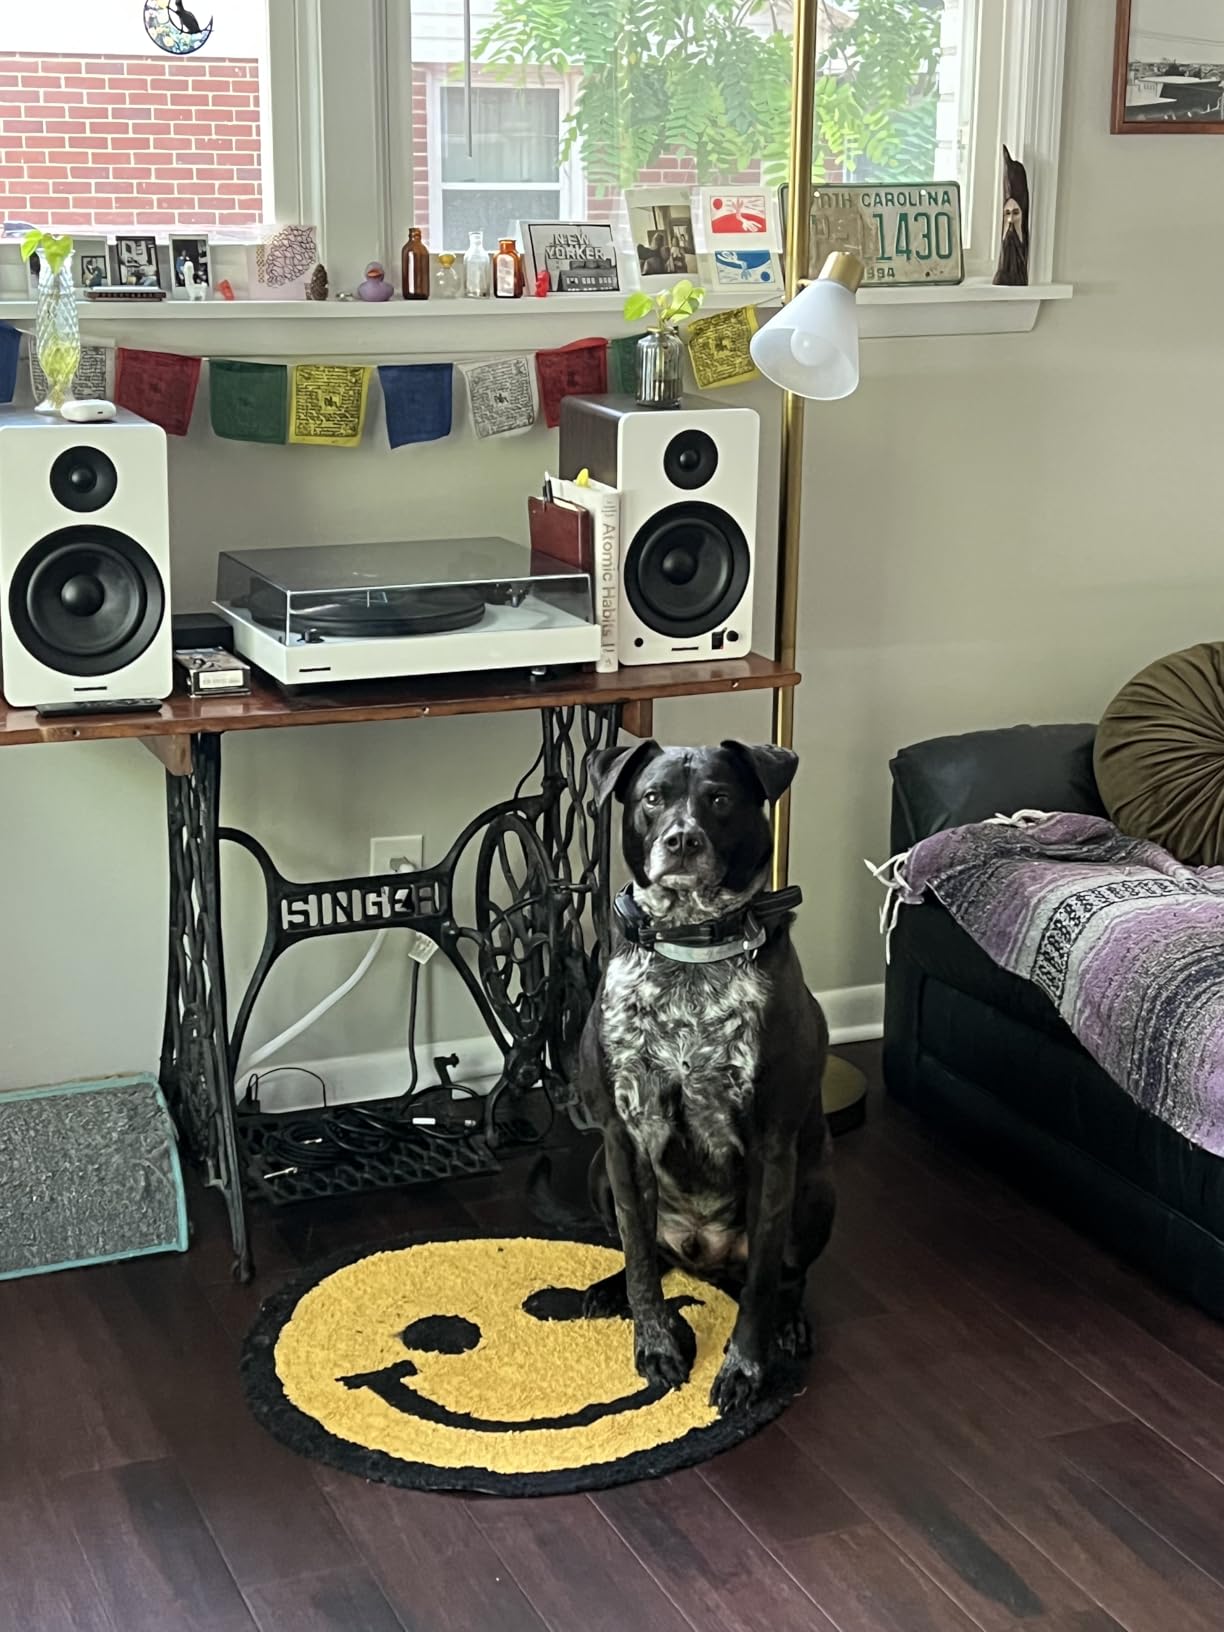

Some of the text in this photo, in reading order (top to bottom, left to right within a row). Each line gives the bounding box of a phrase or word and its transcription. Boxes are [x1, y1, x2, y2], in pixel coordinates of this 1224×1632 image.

[861, 190, 951, 208] CAROLINA
[545, 245, 605, 260] YORKER
[551, 232, 590, 247] NEW
[872, 211, 953, 261] 1430
[602, 523, 616, 581] Atomic
[601, 587, 616, 637] Habits
[281, 882, 441, 931] SINGER
